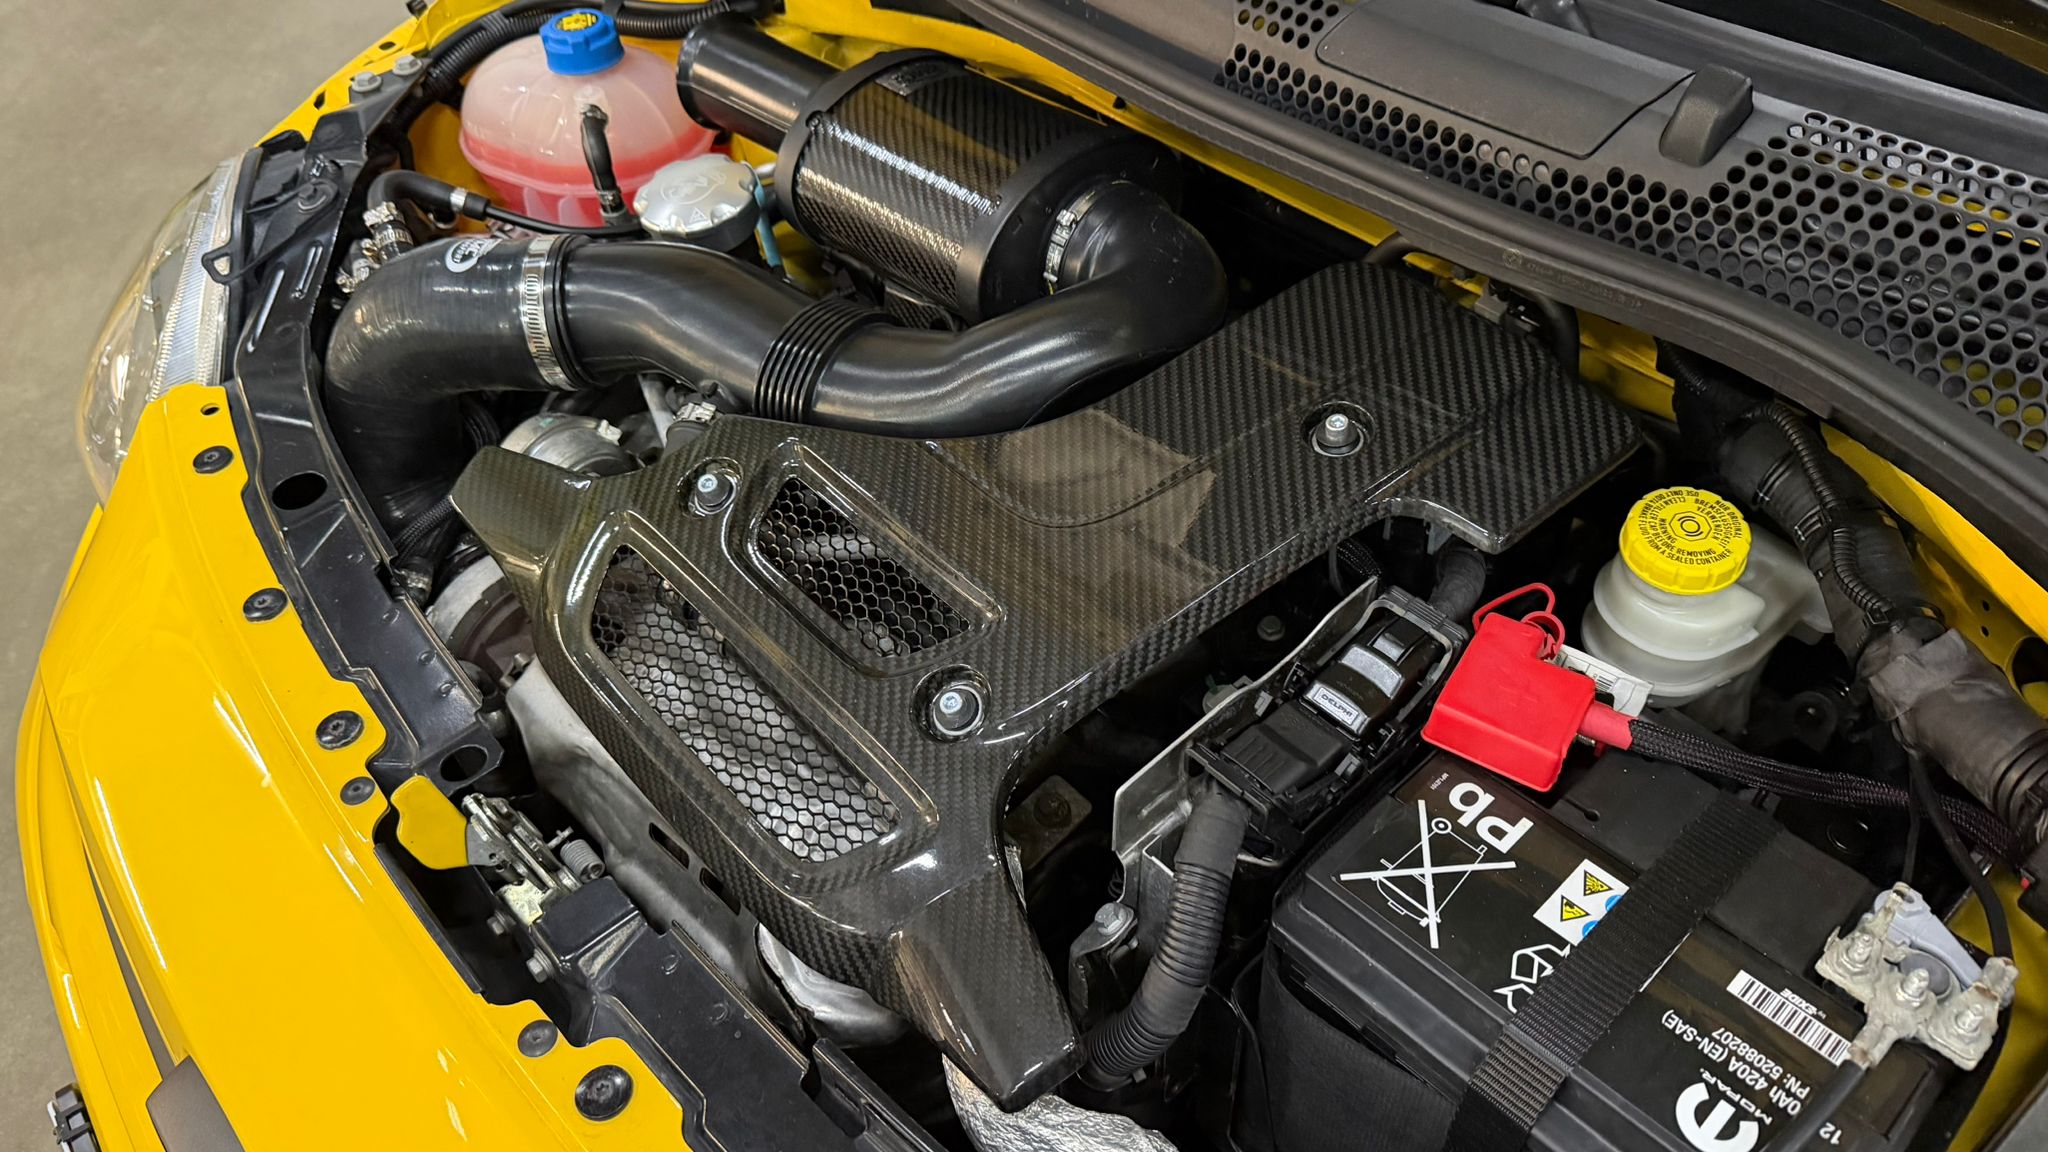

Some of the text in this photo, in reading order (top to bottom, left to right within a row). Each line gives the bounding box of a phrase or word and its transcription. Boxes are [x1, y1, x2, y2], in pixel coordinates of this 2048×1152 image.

[1685, 490, 1700, 498] USE
[1639, 502, 1653, 519] BRAKE
[1696, 506, 1722, 540] VERWENDEN
[1714, 500, 1742, 538] NUR ORIGINAL
[1638, 518, 1648, 536] FLUID
[1648, 496, 1717, 557] CLEAN FILLER CAP BEFORE REMOVING
[1659, 517, 1677, 544] WARNING
[1644, 535, 1662, 551] FROM
[1660, 548, 1666, 556] A
[1695, 548, 1733, 565] CONTAINER
[1666, 552, 1694, 564] SEALED
[1321, 694, 1353, 718] DELPHI
[1448, 782, 1534, 854] Pb
[1780, 988, 1817, 1016] EXIDE
[1662, 1009, 1728, 1062] (EN-SAE)
[1712, 1027, 1811, 1100] PN: 52088207
[1728, 1056, 1768, 1092] 420A
[1768, 1085, 1801, 1116] 0Ah
